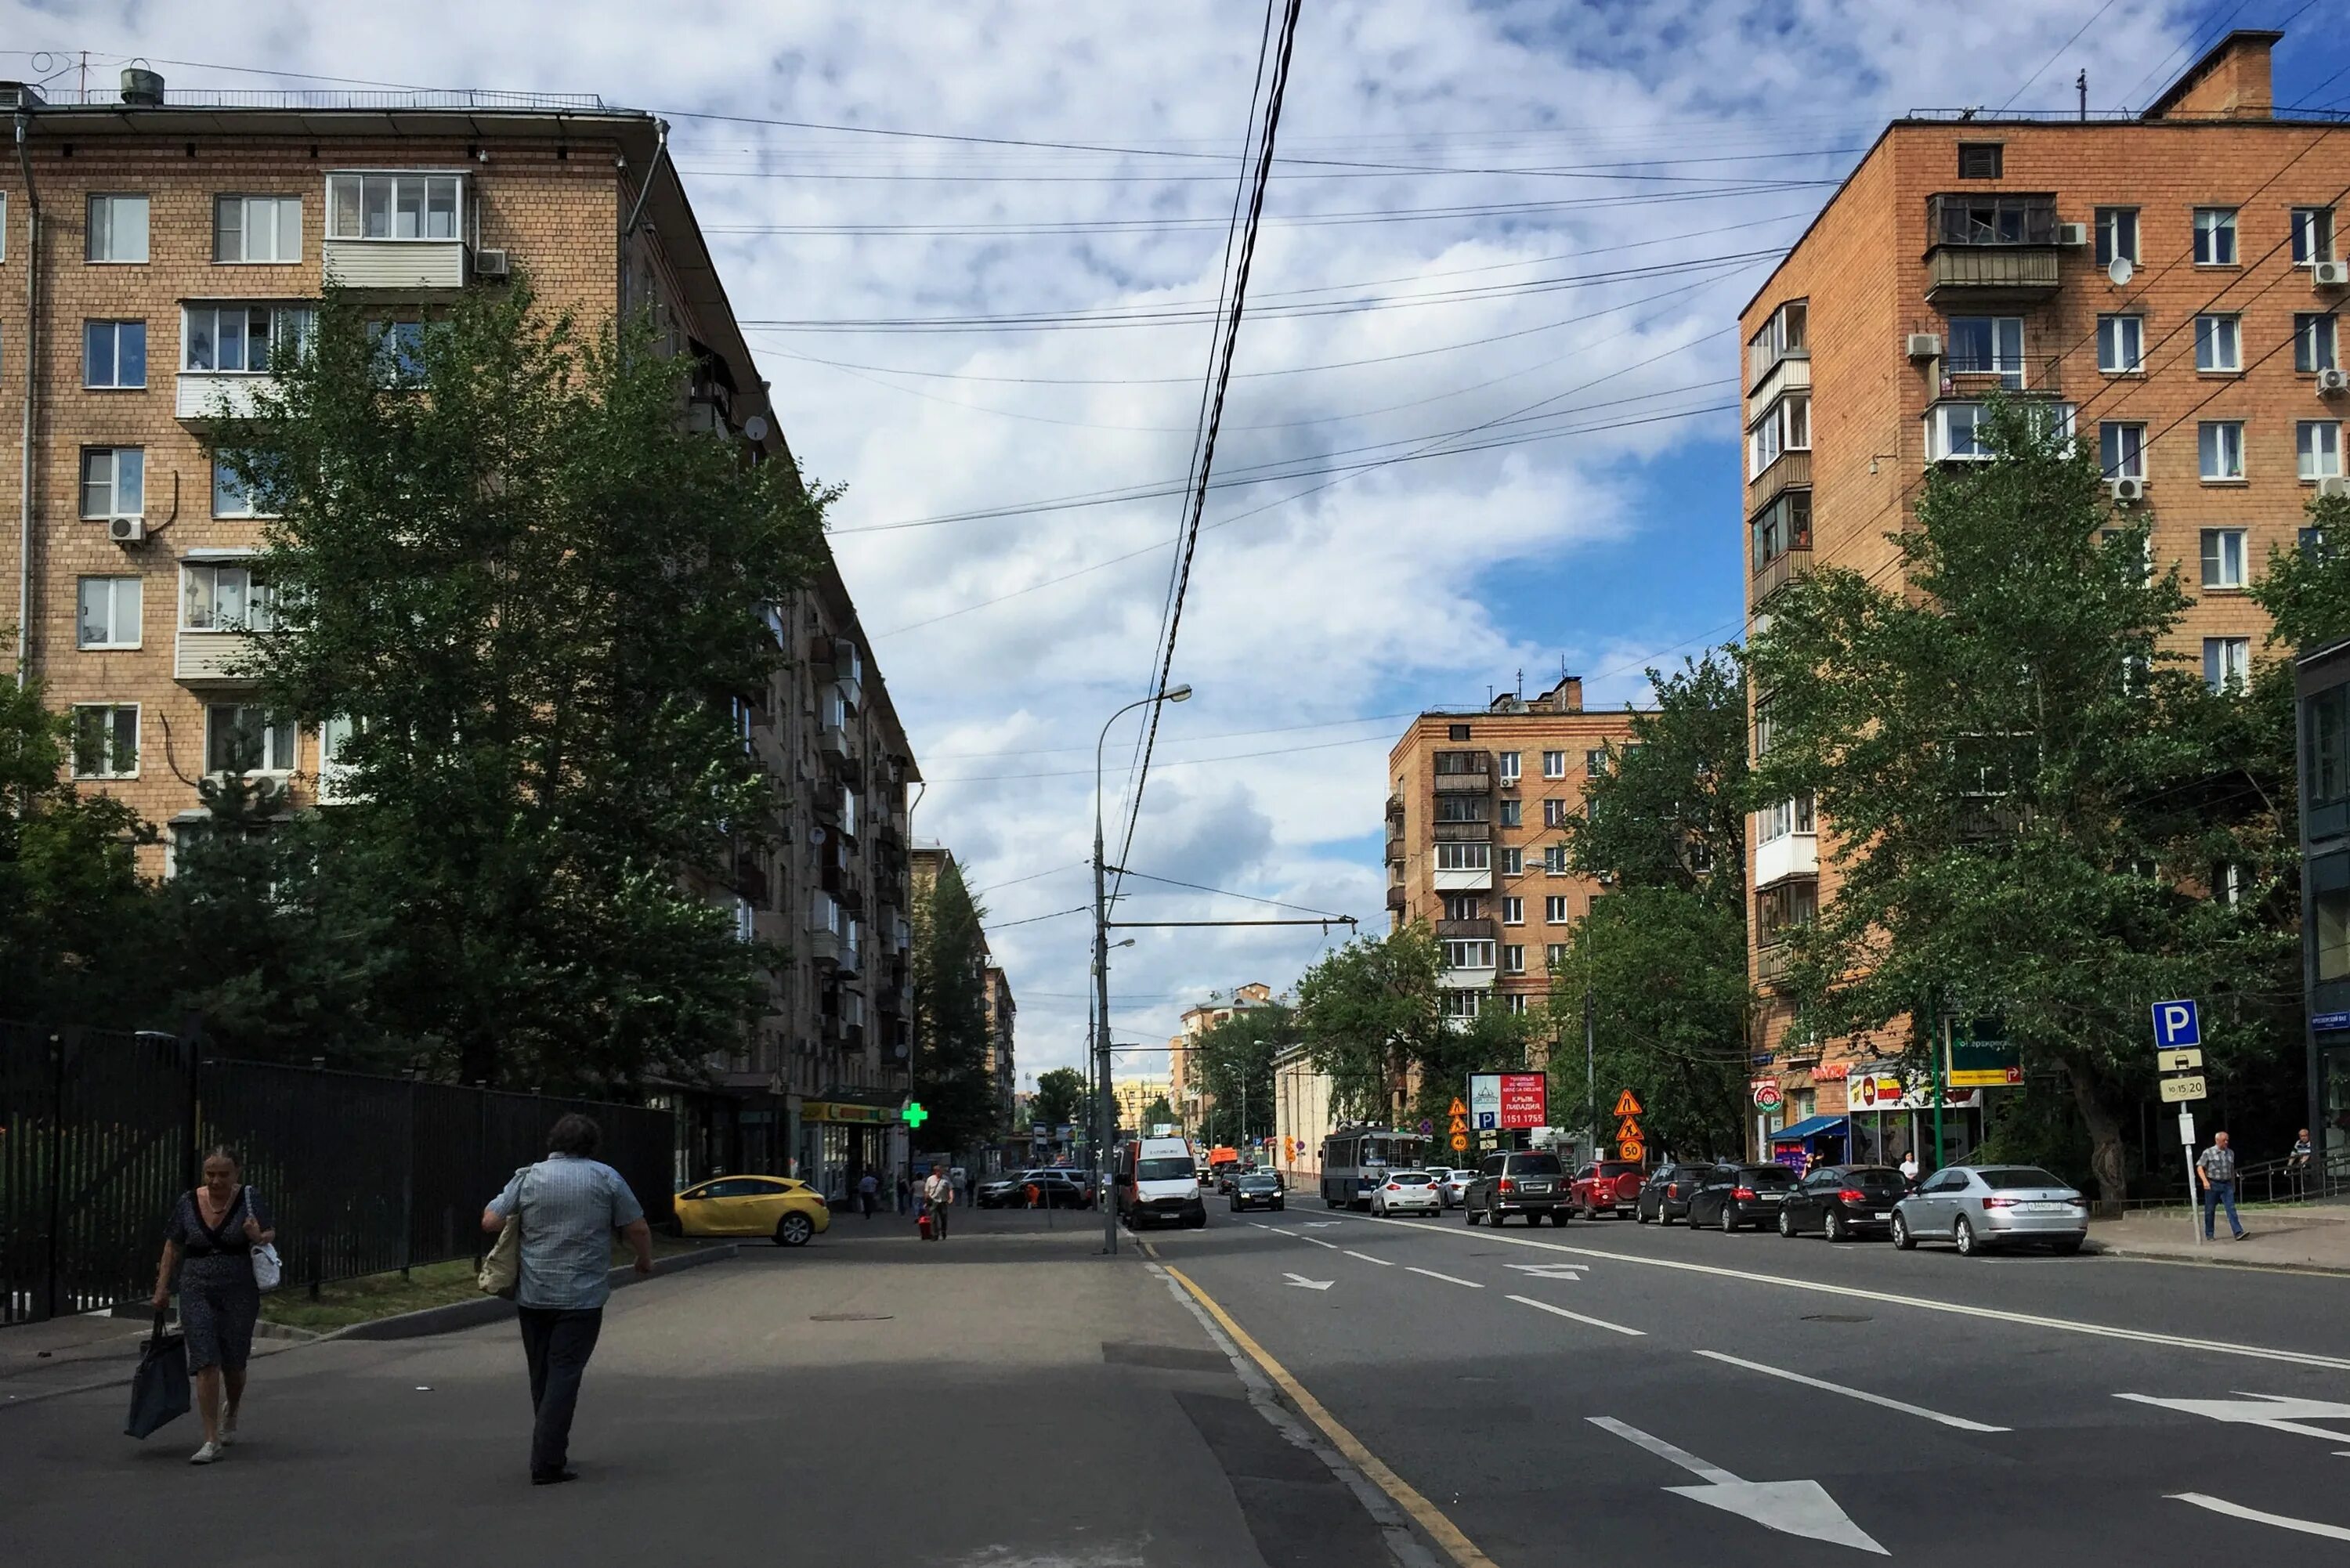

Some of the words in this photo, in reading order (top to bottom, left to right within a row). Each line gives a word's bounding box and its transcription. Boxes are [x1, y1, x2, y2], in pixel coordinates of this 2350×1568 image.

[2164, 1006, 2189, 1042] P
[2189, 1082, 2202, 1093] 20
[1483, 1113, 1492, 1127] P
[1524, 1114, 1543, 1122] 1755
[1625, 1147, 1638, 1157] 50
